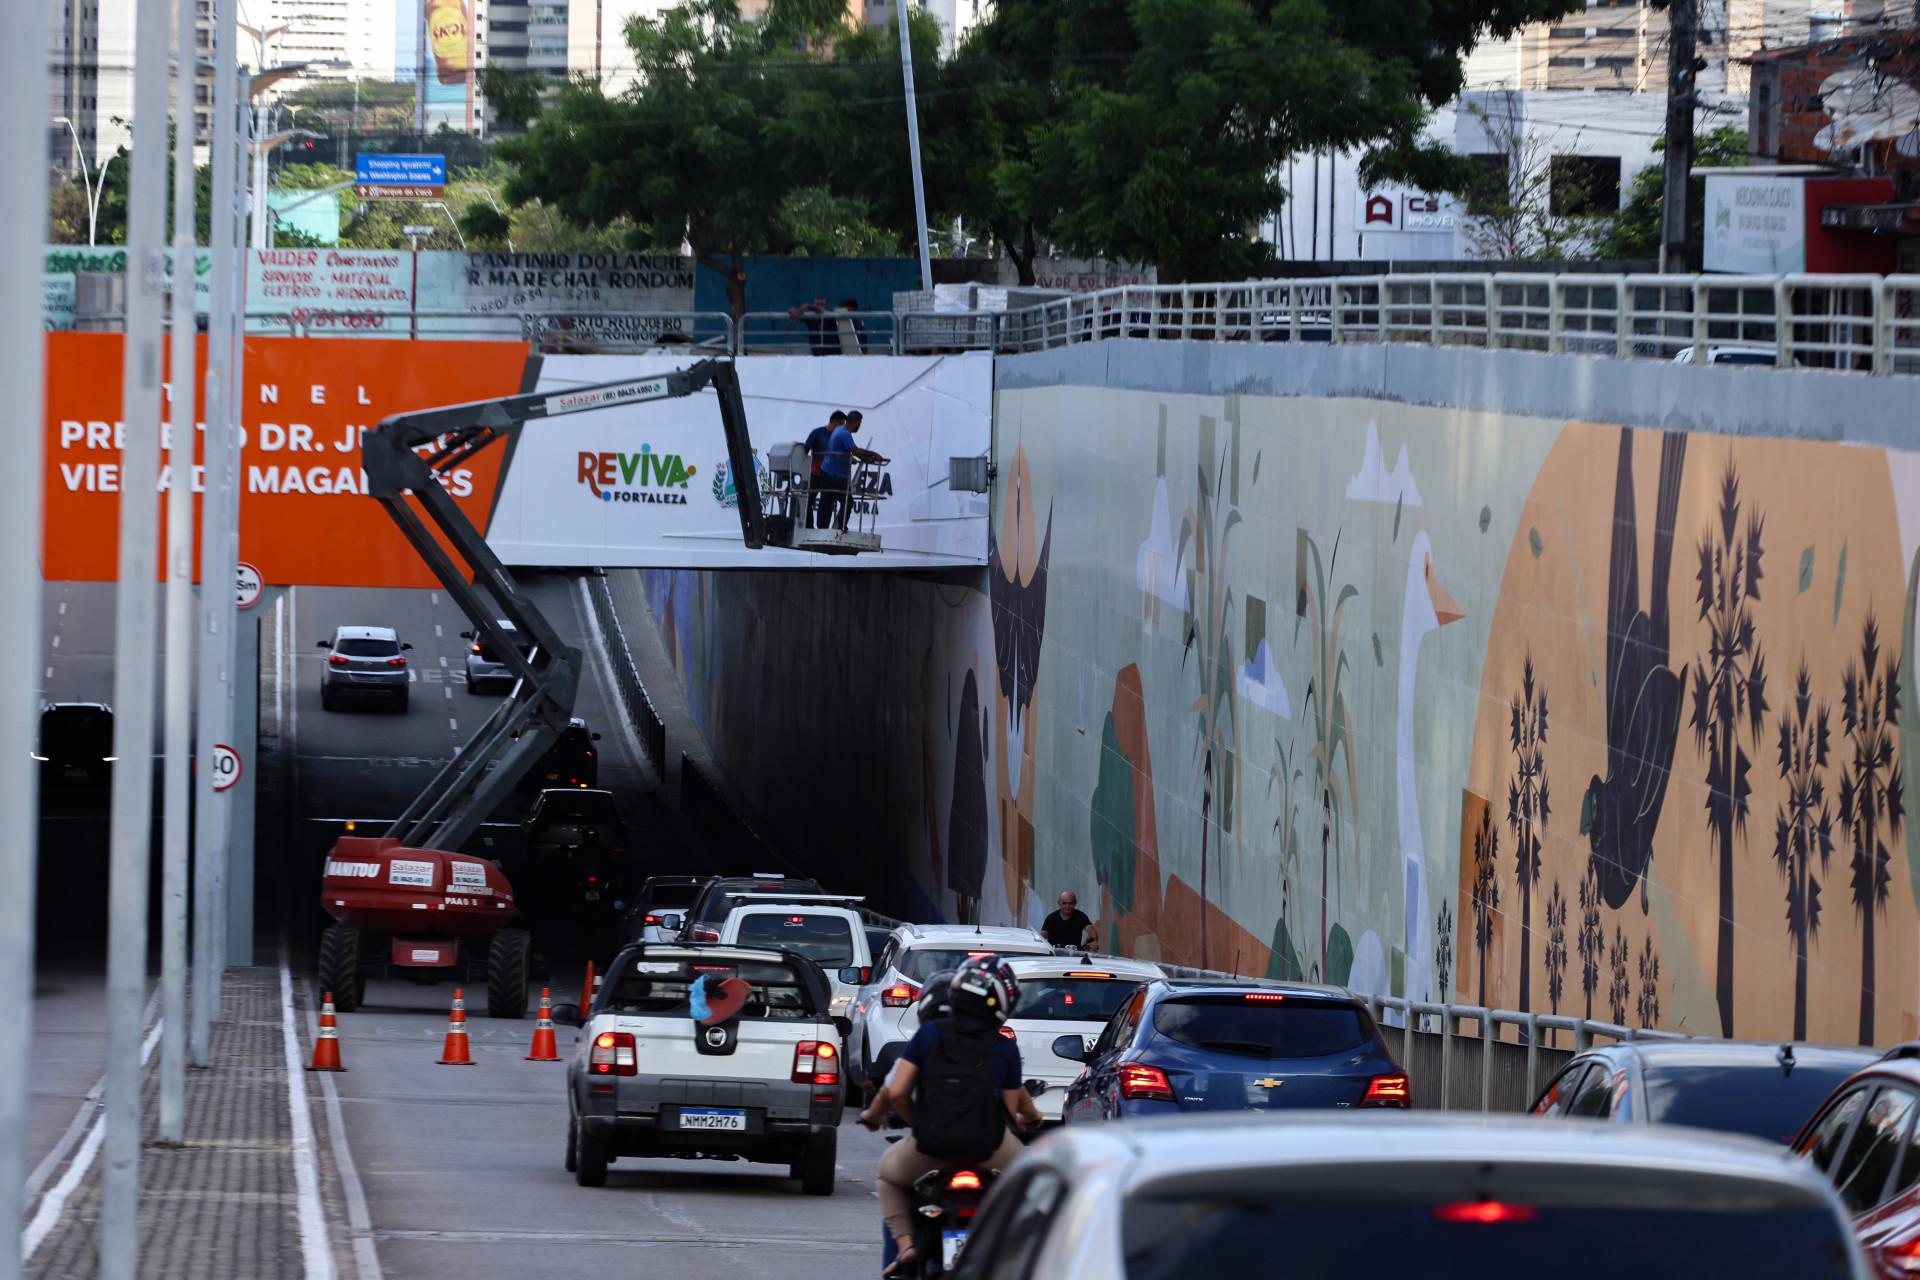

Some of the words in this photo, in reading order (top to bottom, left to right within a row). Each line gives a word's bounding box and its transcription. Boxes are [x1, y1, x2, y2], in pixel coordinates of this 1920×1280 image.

[368, 160, 400, 170] Shopping
[257, 250, 319, 266] VALDER
[469, 253, 570, 269] CANTINHO
[578, 254, 607, 270] DO
[612, 255, 686, 271] LANCHE
[488, 271, 603, 288] MARECHAL
[608, 272, 694, 289] RONDOM
[560, 393, 602, 408] Salazar
[259, 423, 326, 453] DR.
[578, 443, 692, 499] REVIVA
[614, 491, 688, 505] FORTALEZA
[392, 863, 432, 873] Salazar
[453, 864, 482, 873] Salazar
[685, 1115, 738, 1128] NMM2H76
